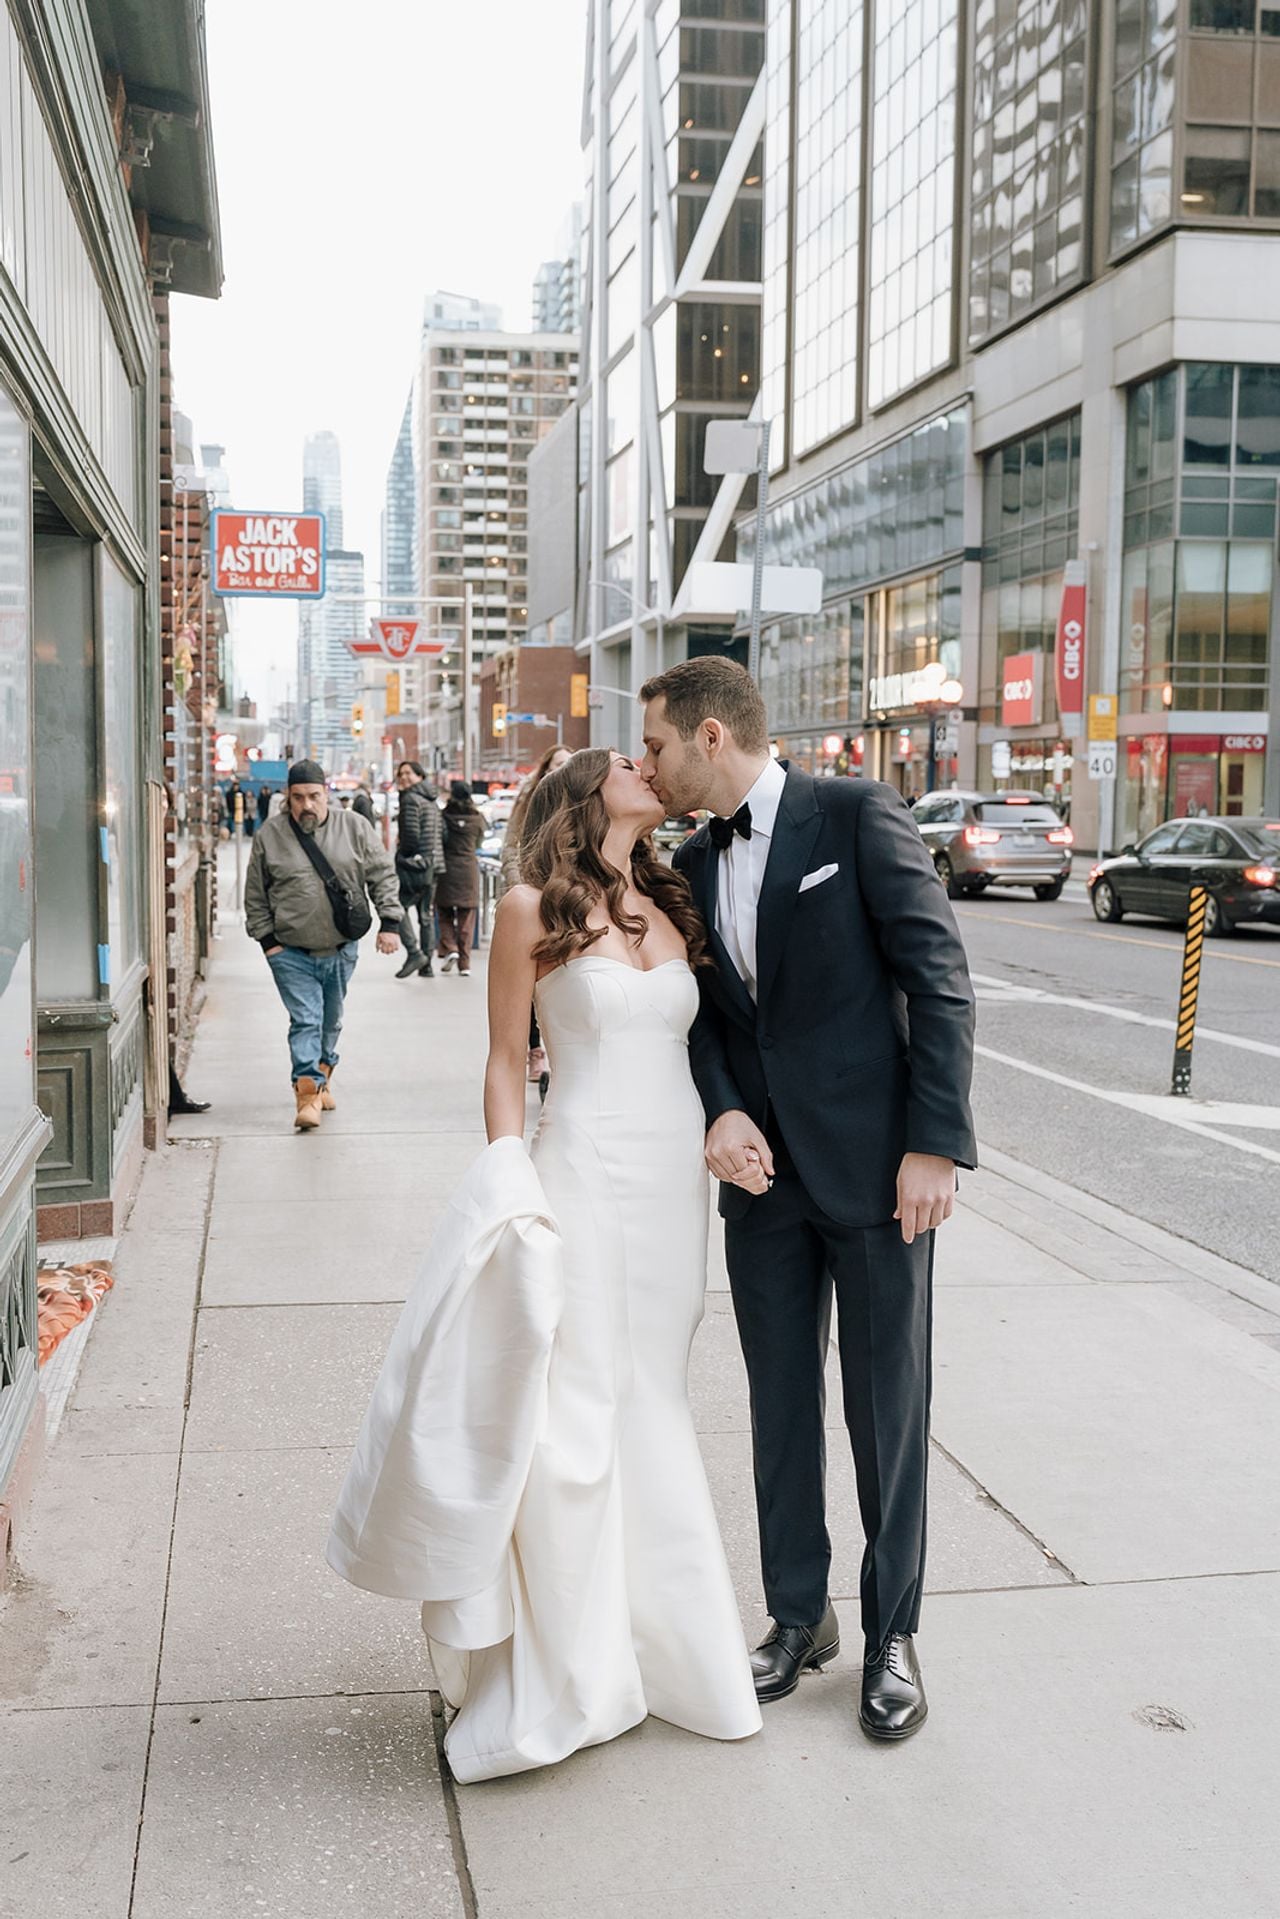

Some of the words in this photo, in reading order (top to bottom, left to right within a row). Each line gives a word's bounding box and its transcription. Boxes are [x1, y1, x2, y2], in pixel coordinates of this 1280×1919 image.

[239, 518, 298, 546] JACK
[221, 545, 318, 575] ASTOR'S
[1064, 638, 1080, 680] CIBC
[1225, 735, 1251, 749] CIBC
[1090, 757, 1114, 775] 40
